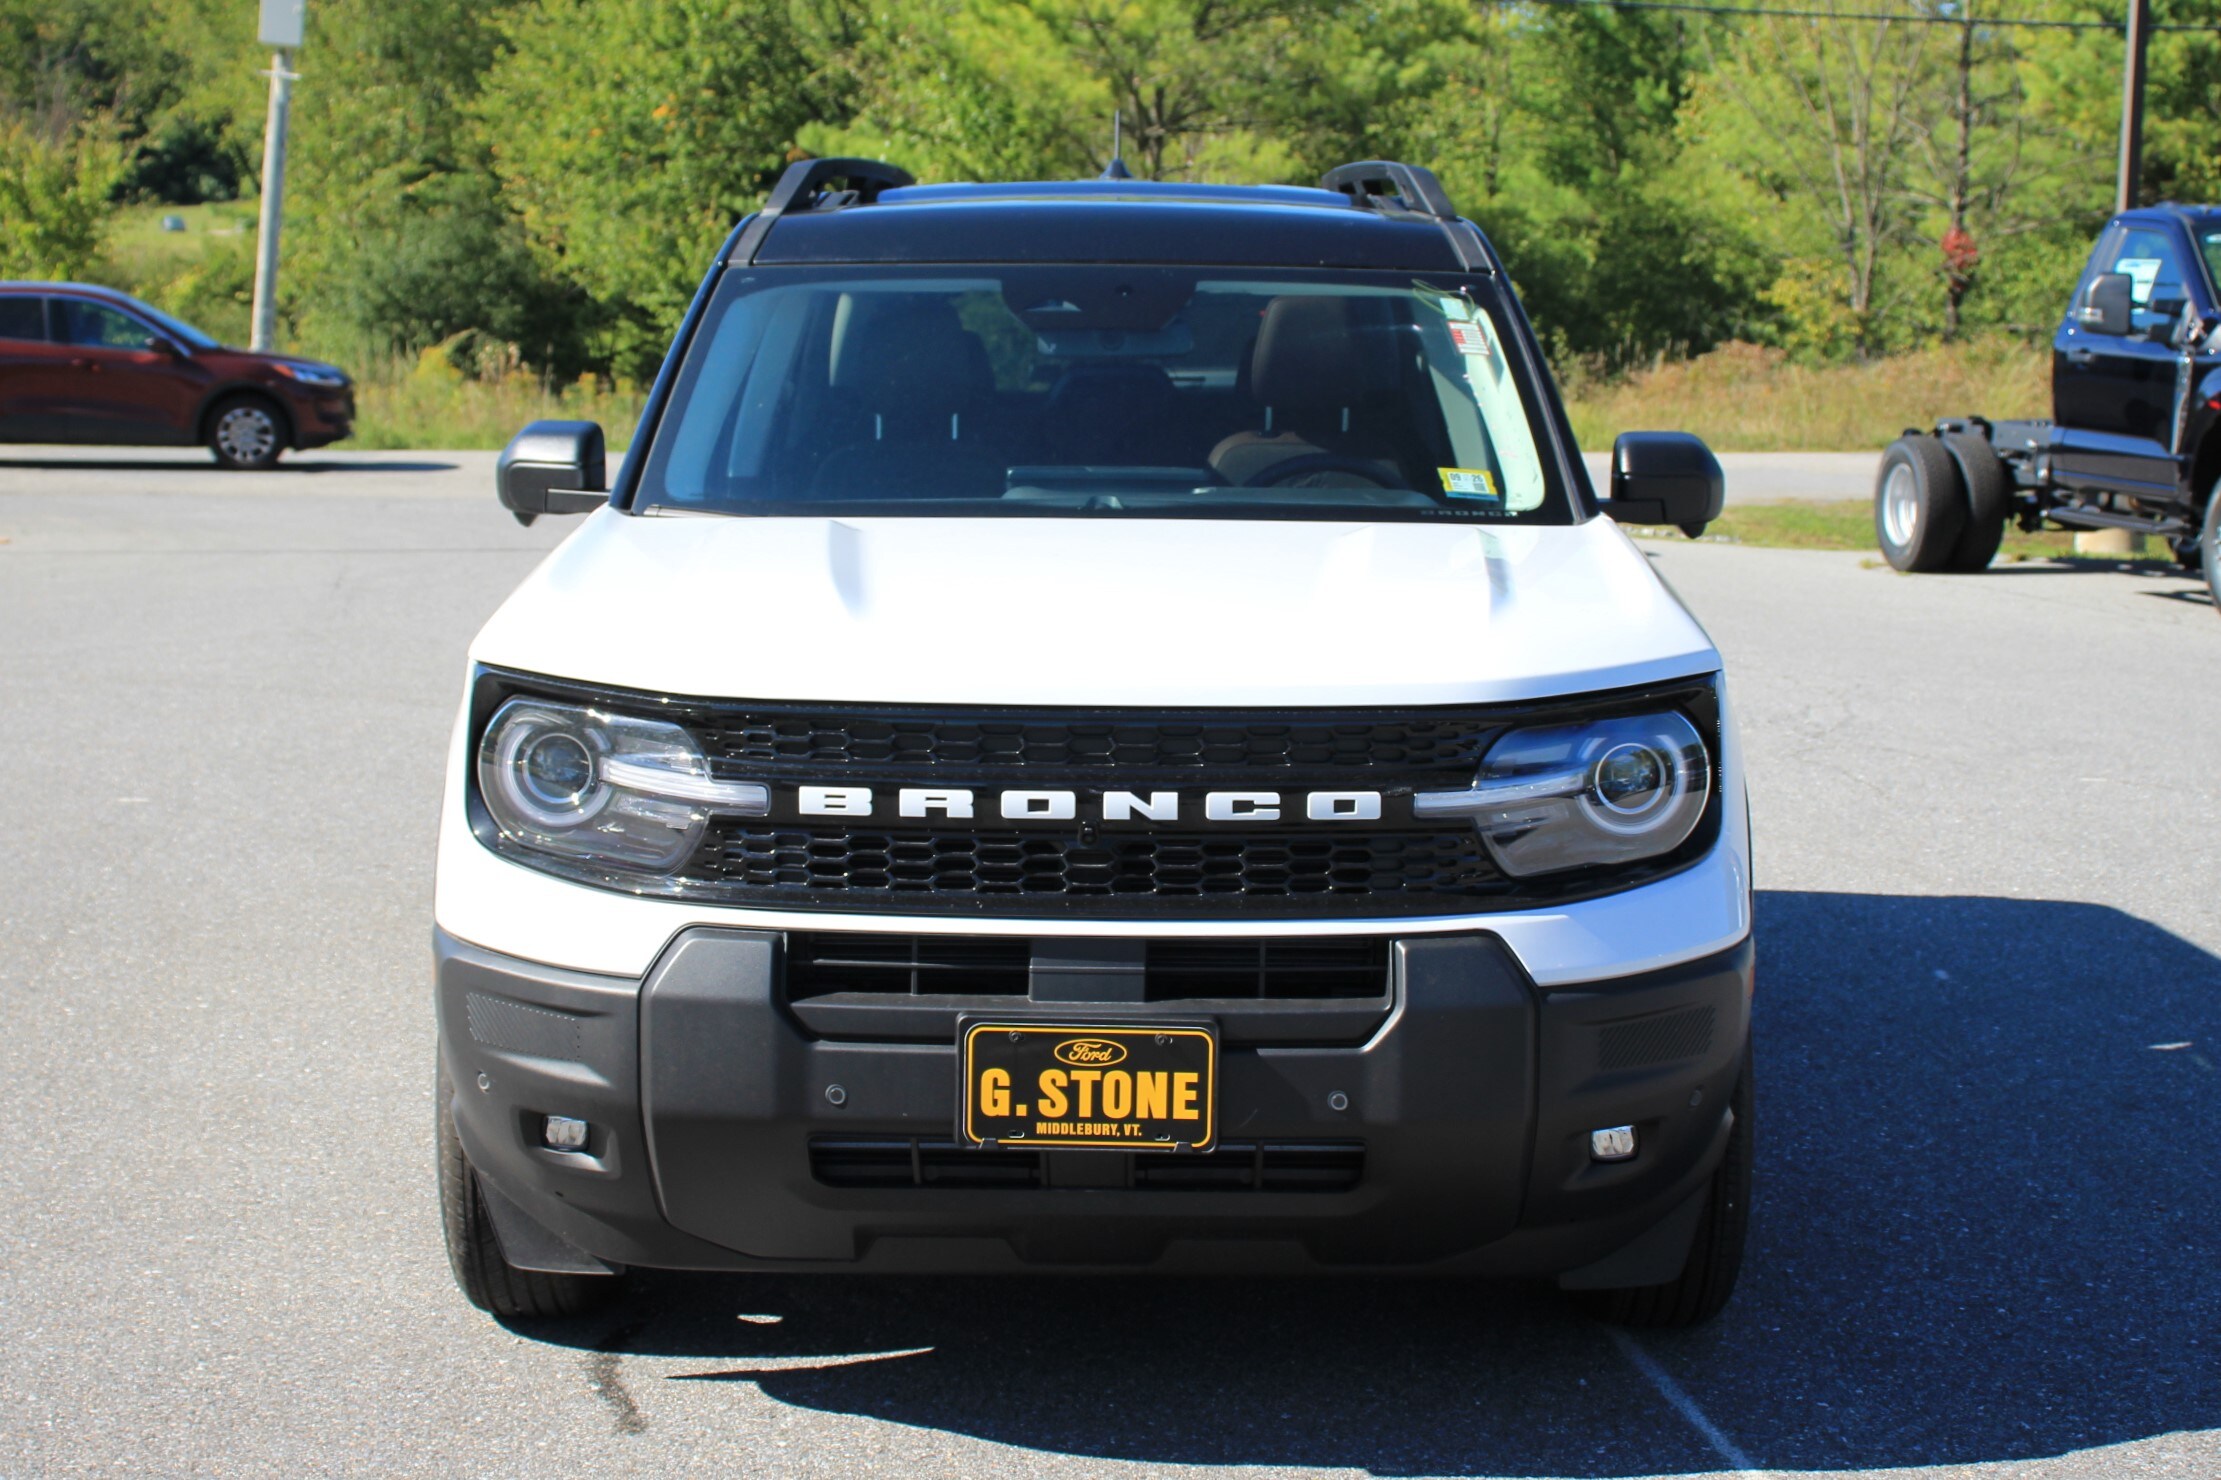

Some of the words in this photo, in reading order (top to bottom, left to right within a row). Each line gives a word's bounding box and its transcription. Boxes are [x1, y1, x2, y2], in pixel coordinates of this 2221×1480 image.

[798, 785, 1382, 820] BRONCO
[1068, 1042, 1112, 1062] Ford
[980, 1068, 1028, 1117] G.
[1038, 1069, 1199, 1120] STONE
[1036, 1121, 1121, 1137] MIDDLEBURY,
[1123, 1124, 1142, 1137] VT.
